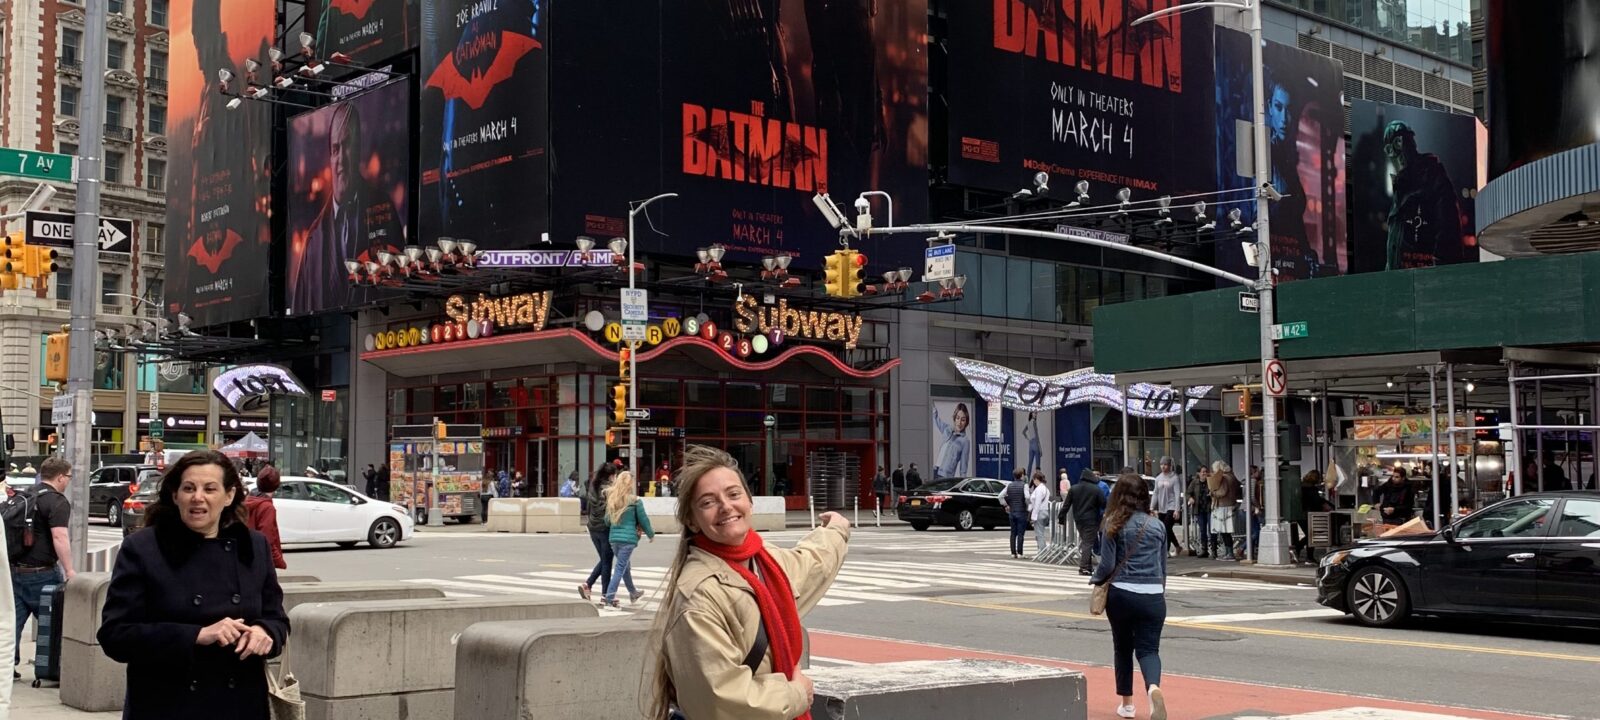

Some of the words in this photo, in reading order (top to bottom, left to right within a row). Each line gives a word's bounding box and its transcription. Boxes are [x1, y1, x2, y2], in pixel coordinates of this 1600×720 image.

[362, 22, 378, 37] MARCH
[455, 33, 497, 65] CATWOMAN
[751, 100, 764, 117] THE
[1050, 81, 1074, 104] ONLY
[1077, 89, 1085, 107] IN
[1090, 91, 1134, 118] THEATERS
[480, 120, 507, 145] MARCH
[511, 117, 517, 137] 4
[1052, 107, 1113, 154] MARCH
[1123, 125, 1134, 159] 4
[682, 102, 828, 194] BATMAN
[18, 153, 28, 173] 7
[1032, 161, 1051, 174] Dolby
[1052, 164, 1075, 177] Cinema
[1078, 169, 1118, 185] EXPERIENCE
[1119, 176, 1124, 185] IT
[1133, 178, 1158, 190] IMAX
[753, 211, 782, 225] THEATERS
[41, 223, 72, 239] ONE
[98, 229, 117, 242] AY
[730, 223, 769, 245] MARCH
[774, 231, 782, 245] 4
[1057, 227, 1102, 241] OUTFRONT
[480, 253, 563, 265] OUTFRONT
[446, 291, 549, 331] Subway
[1246, 298, 1257, 306] ONE
[735, 293, 863, 349] Subway
[1284, 325, 1290, 336] W
[1290, 324, 1300, 336] 42
[376, 335, 384, 346] N
[398, 331, 405, 343] R
[408, 330, 418, 343] W
[421, 329, 428, 341] S
[433, 327, 438, 340] 1
[444, 327, 451, 339] 2
[456, 327, 464, 338] 3
[481, 321, 488, 334] 7
[610, 326, 620, 339] N
[650, 330, 660, 341] R
[666, 322, 679, 334] W
[687, 320, 697, 333] S
[706, 325, 713, 337] 1
[723, 335, 731, 348] 2
[741, 341, 749, 354] 3
[774, 330, 781, 342] 7
[978, 444, 994, 455] WITH
